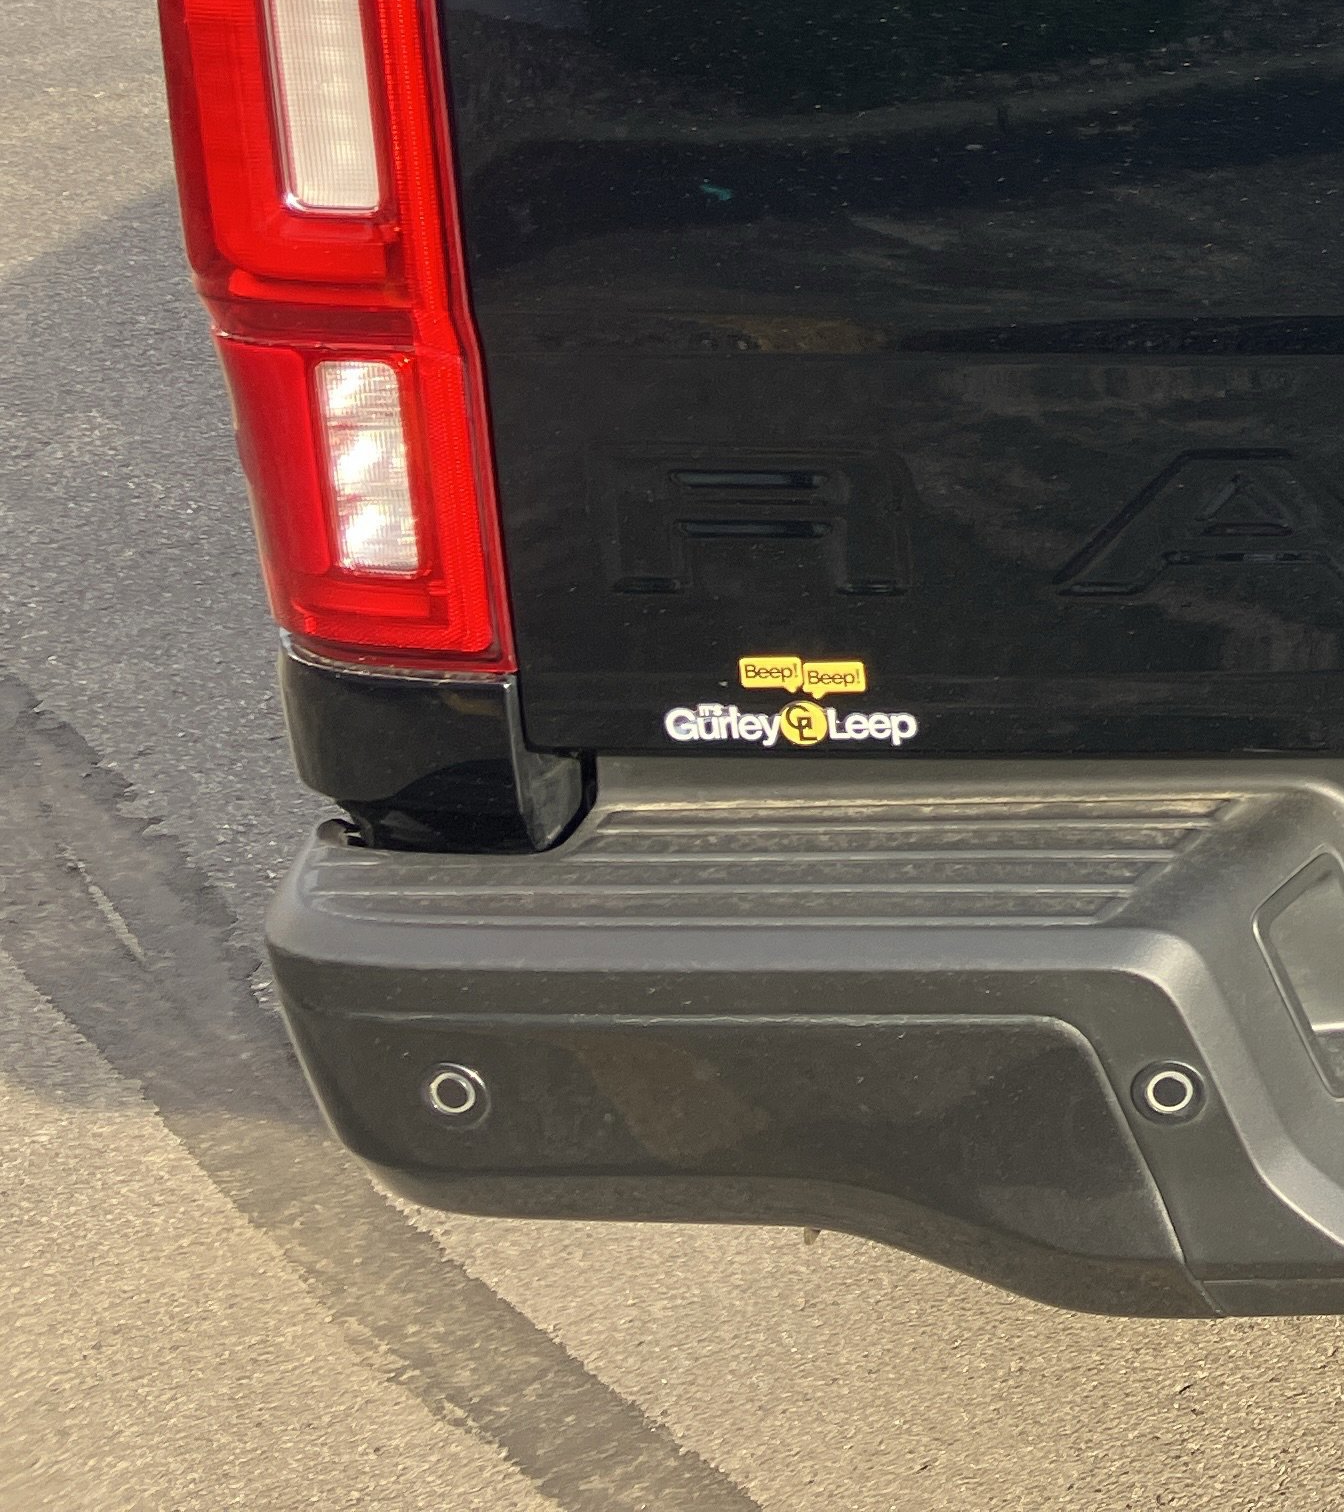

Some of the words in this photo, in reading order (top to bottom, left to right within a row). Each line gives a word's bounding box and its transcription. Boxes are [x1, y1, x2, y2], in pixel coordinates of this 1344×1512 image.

[743, 663, 799, 681] Beep!
[807, 668, 860, 687] Beep!
[663, 704, 781, 747] Gurley
[827, 706, 919, 746] Leep
